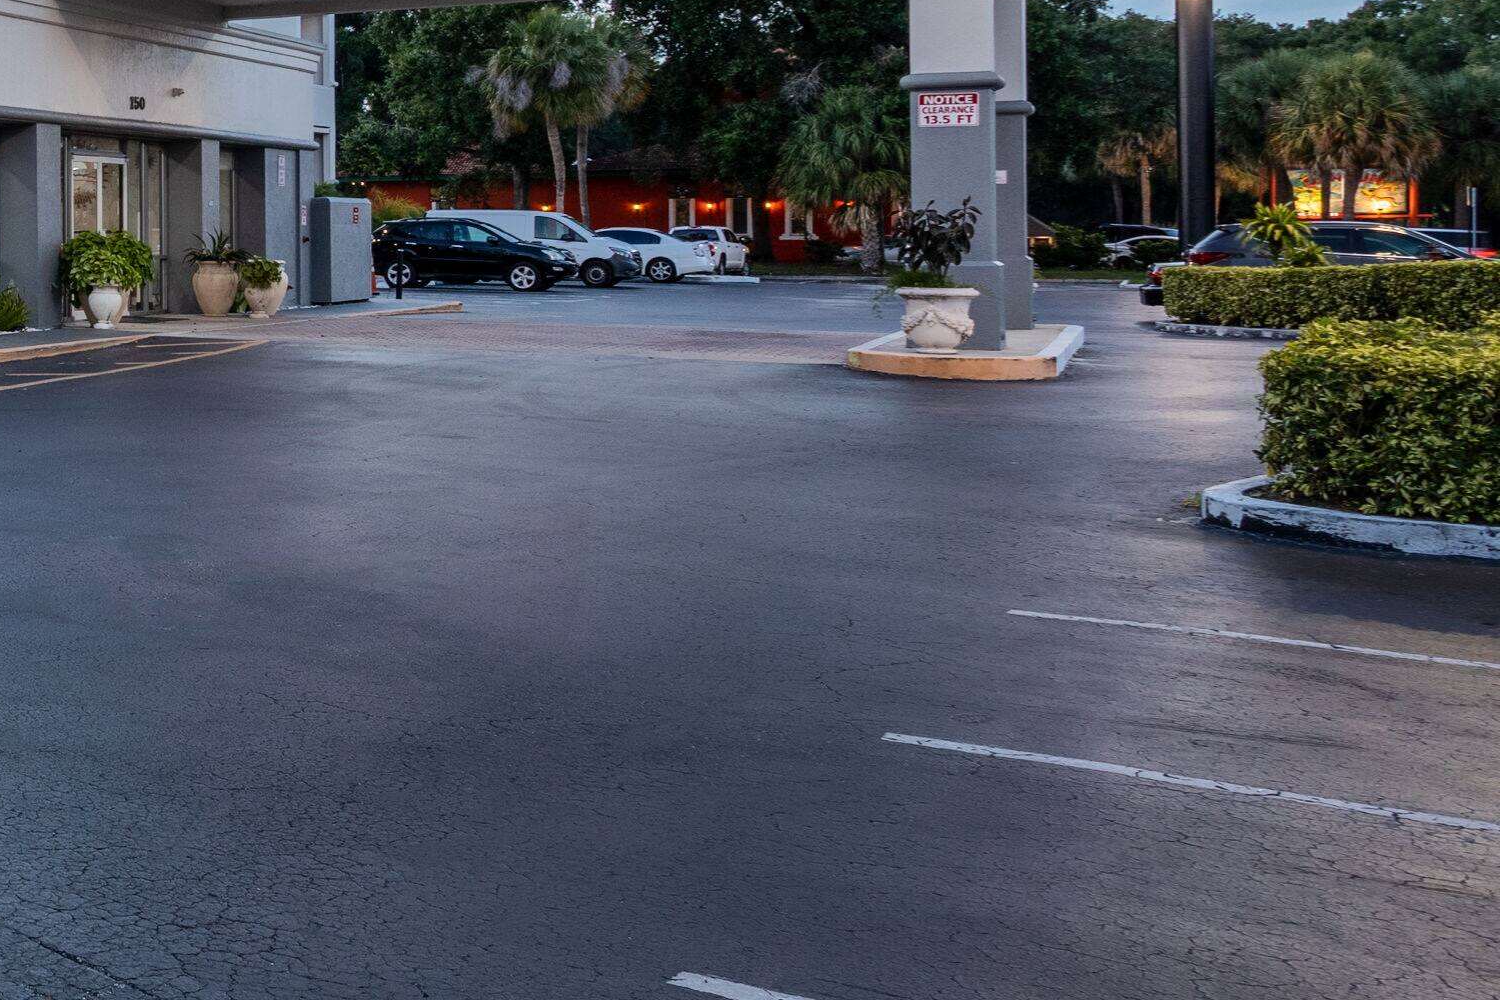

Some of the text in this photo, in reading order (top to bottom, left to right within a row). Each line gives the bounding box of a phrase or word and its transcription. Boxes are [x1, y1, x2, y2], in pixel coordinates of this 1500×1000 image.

[129, 96, 145, 110] 150
[923, 94, 974, 104] NOTICE
[922, 106, 974, 114] CLEARANCE
[924, 115, 973, 124] 13.5 FT
